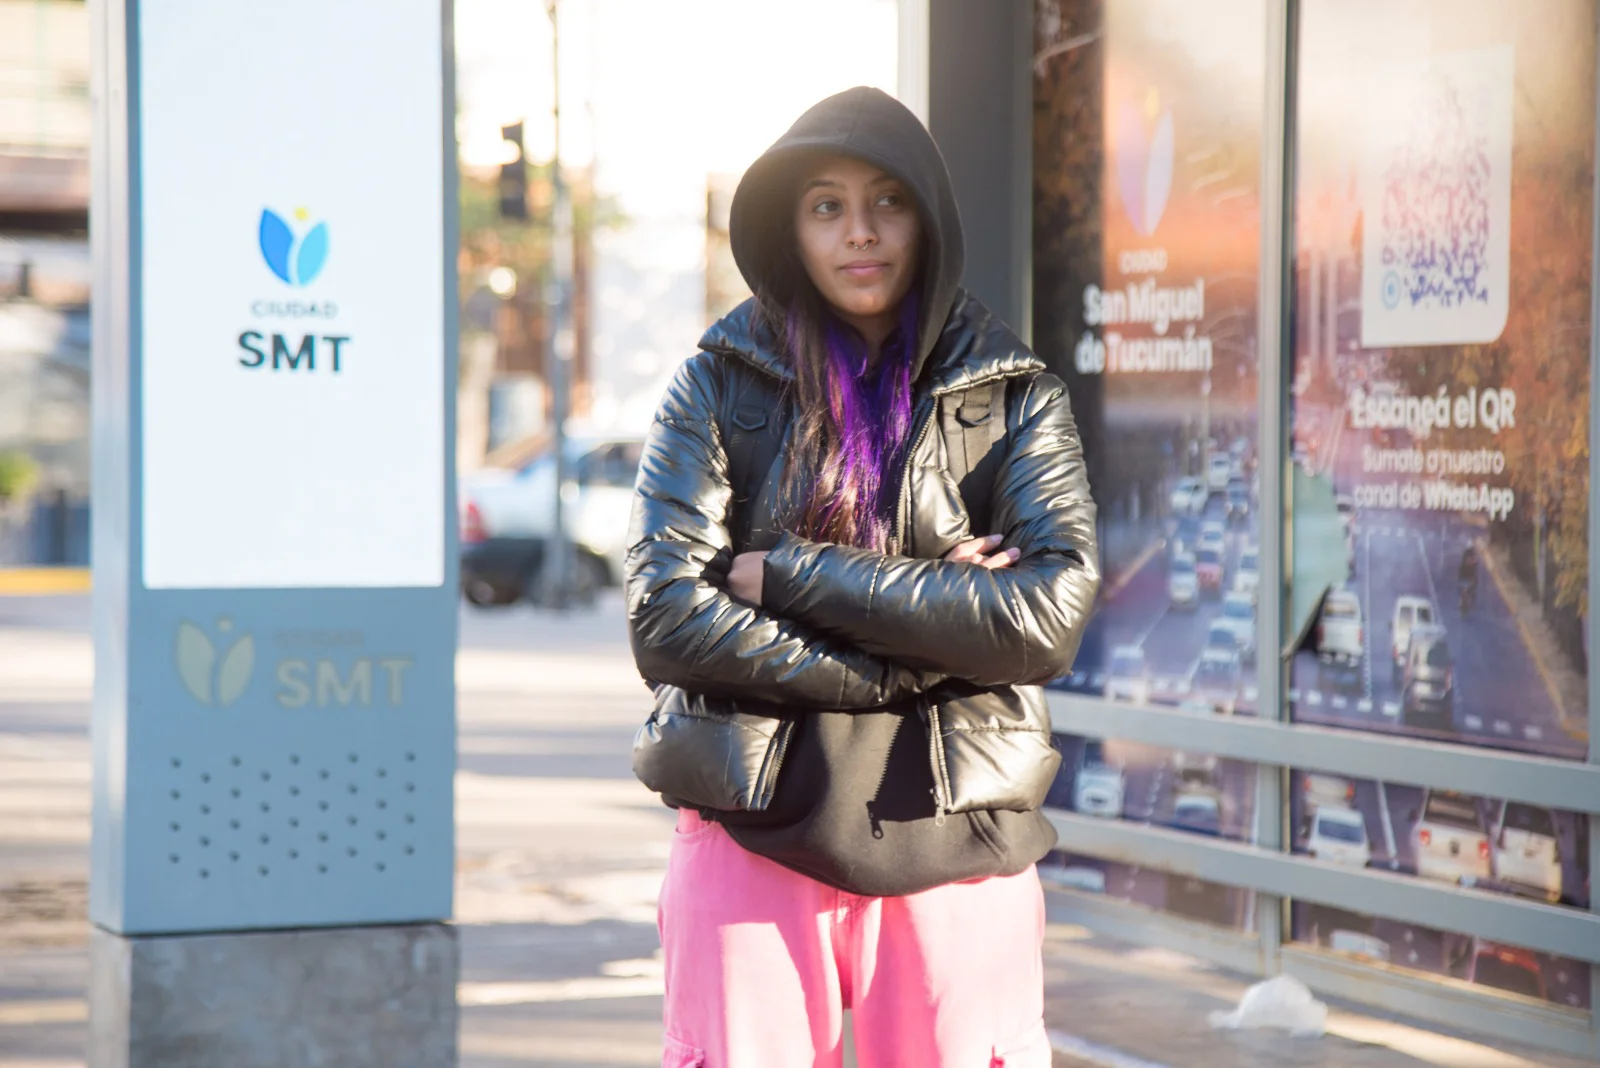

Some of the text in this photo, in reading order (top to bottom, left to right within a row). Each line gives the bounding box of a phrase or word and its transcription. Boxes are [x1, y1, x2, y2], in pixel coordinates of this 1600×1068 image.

[1084, 277, 1205, 334] San Miguel
[238, 331, 350, 372] SMT
[1075, 325, 1213, 373] de Tucumán
[1453, 388, 1477, 428] el
[1480, 389, 1516, 432] QR
[1354, 482, 1514, 522] canal de WhatsApp
[277, 658, 413, 707] SMT
